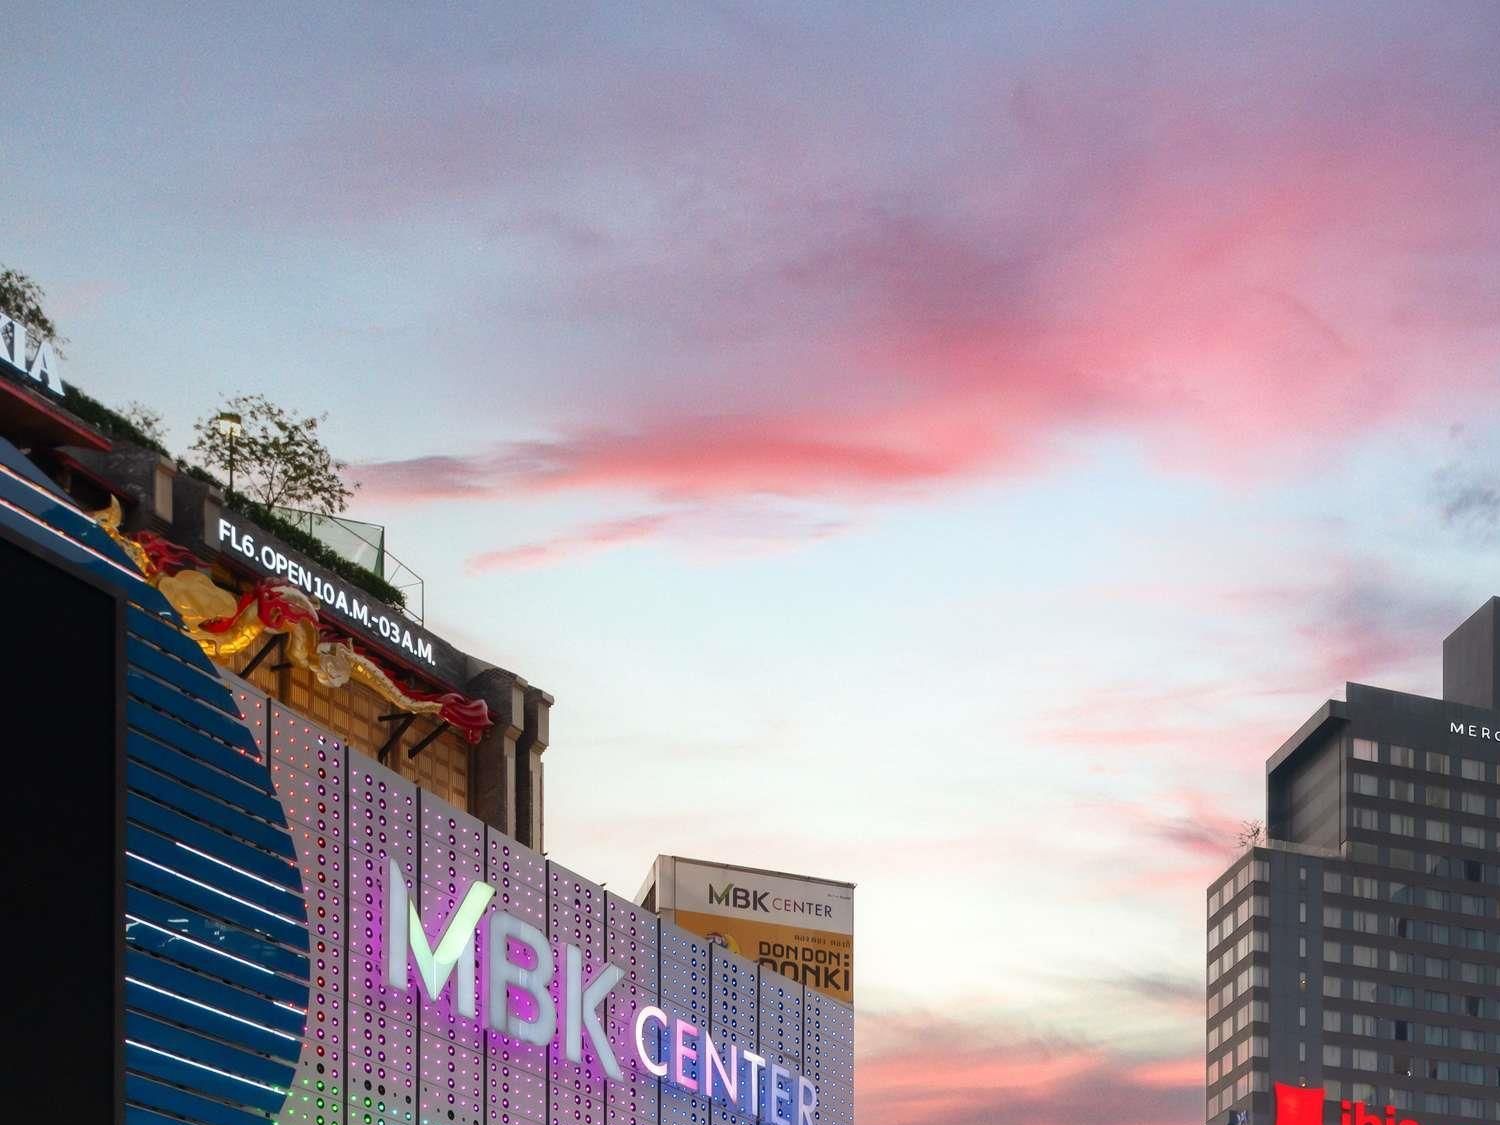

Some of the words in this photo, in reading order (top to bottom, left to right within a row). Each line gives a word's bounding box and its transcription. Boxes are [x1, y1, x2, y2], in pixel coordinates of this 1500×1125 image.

[261, 546, 312, 592] OPEN
[709, 883, 771, 912] MBK
[772, 897, 832, 918] CENTER
[386, 857, 625, 1083] MBK
